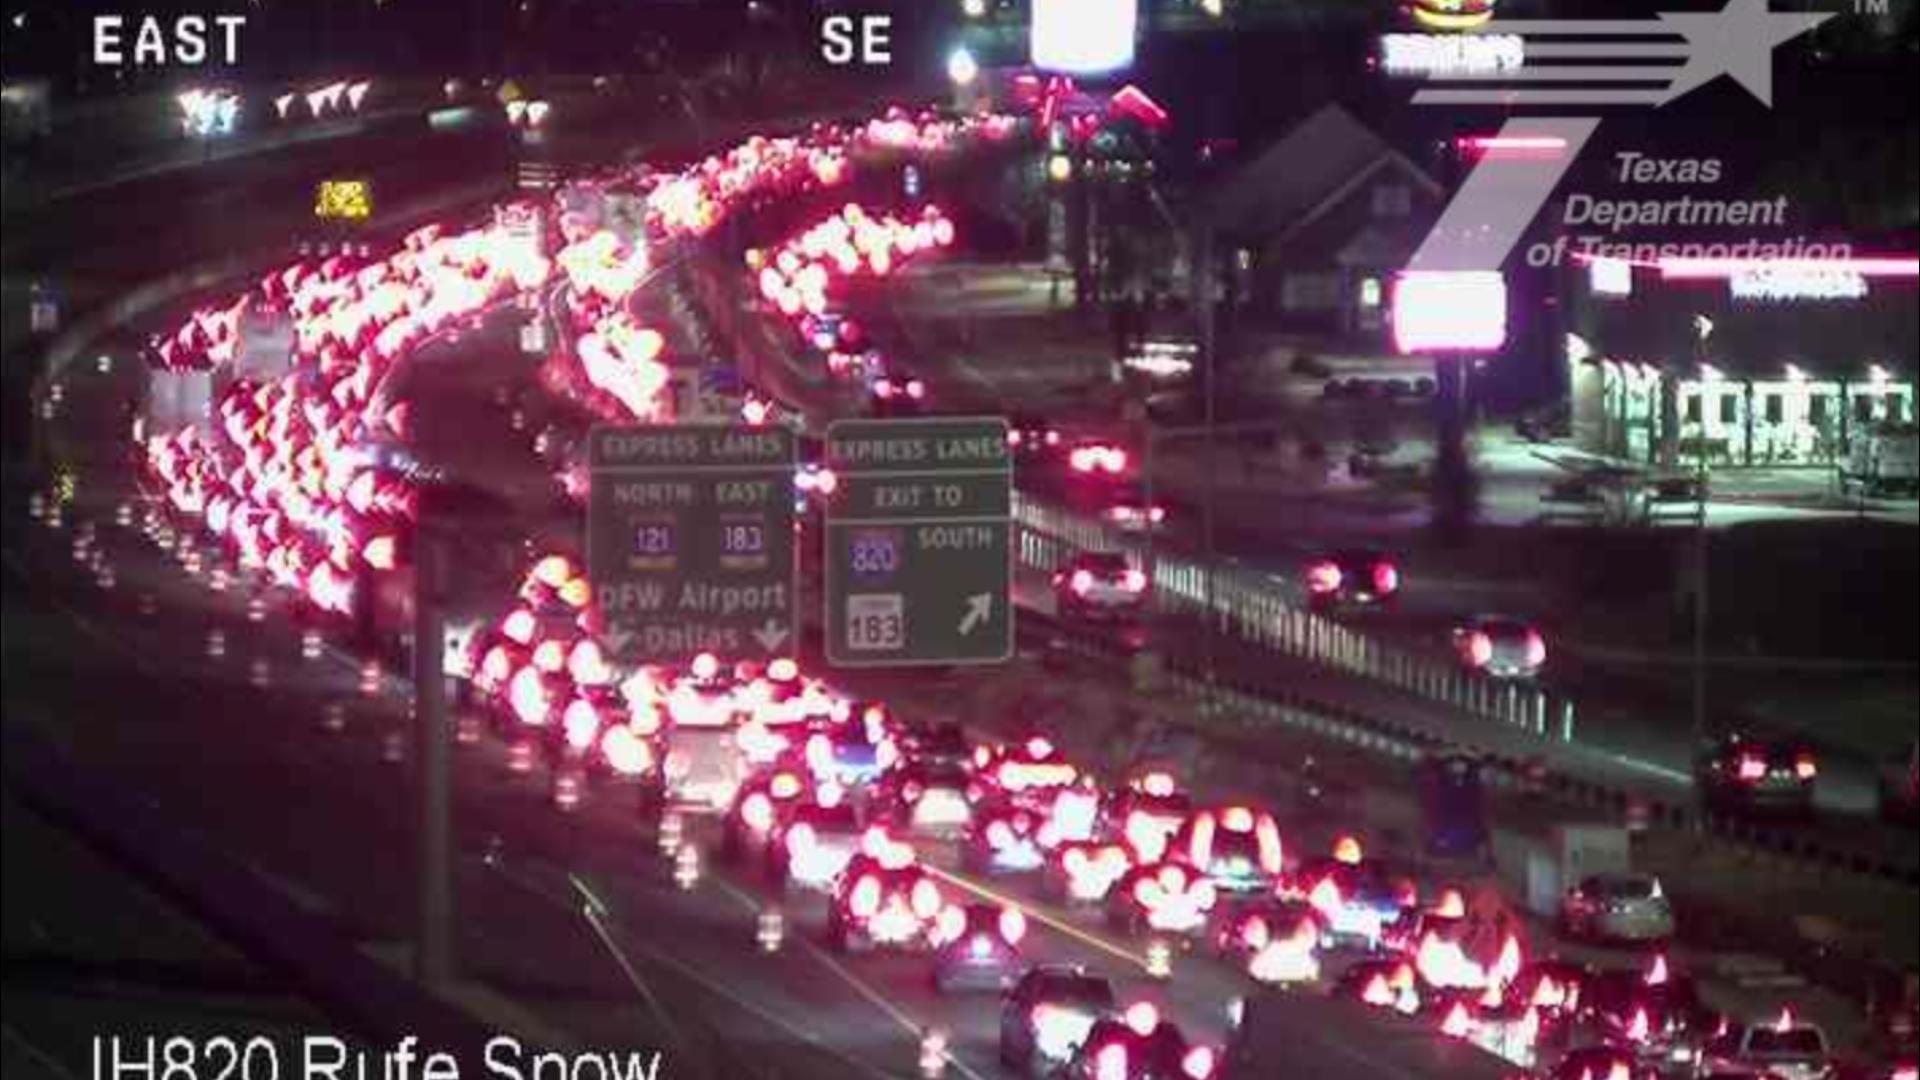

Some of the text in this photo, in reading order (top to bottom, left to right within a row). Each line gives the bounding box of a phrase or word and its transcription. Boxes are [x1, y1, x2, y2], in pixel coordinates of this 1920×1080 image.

[601, 431, 783, 459] EXPRESS LANES
[831, 436, 1004, 463] EXPRESS LANES
[613, 481, 771, 506] NORTH EAST
[873, 484, 963, 507] EXIT TO
[636, 525, 669, 552] 121
[724, 525, 763, 551] 183
[917, 526, 995, 551] SOUTH
[852, 542, 895, 572] 820
[599, 580, 786, 615] DFW Airport
[644, 624, 740, 652] Dallas
